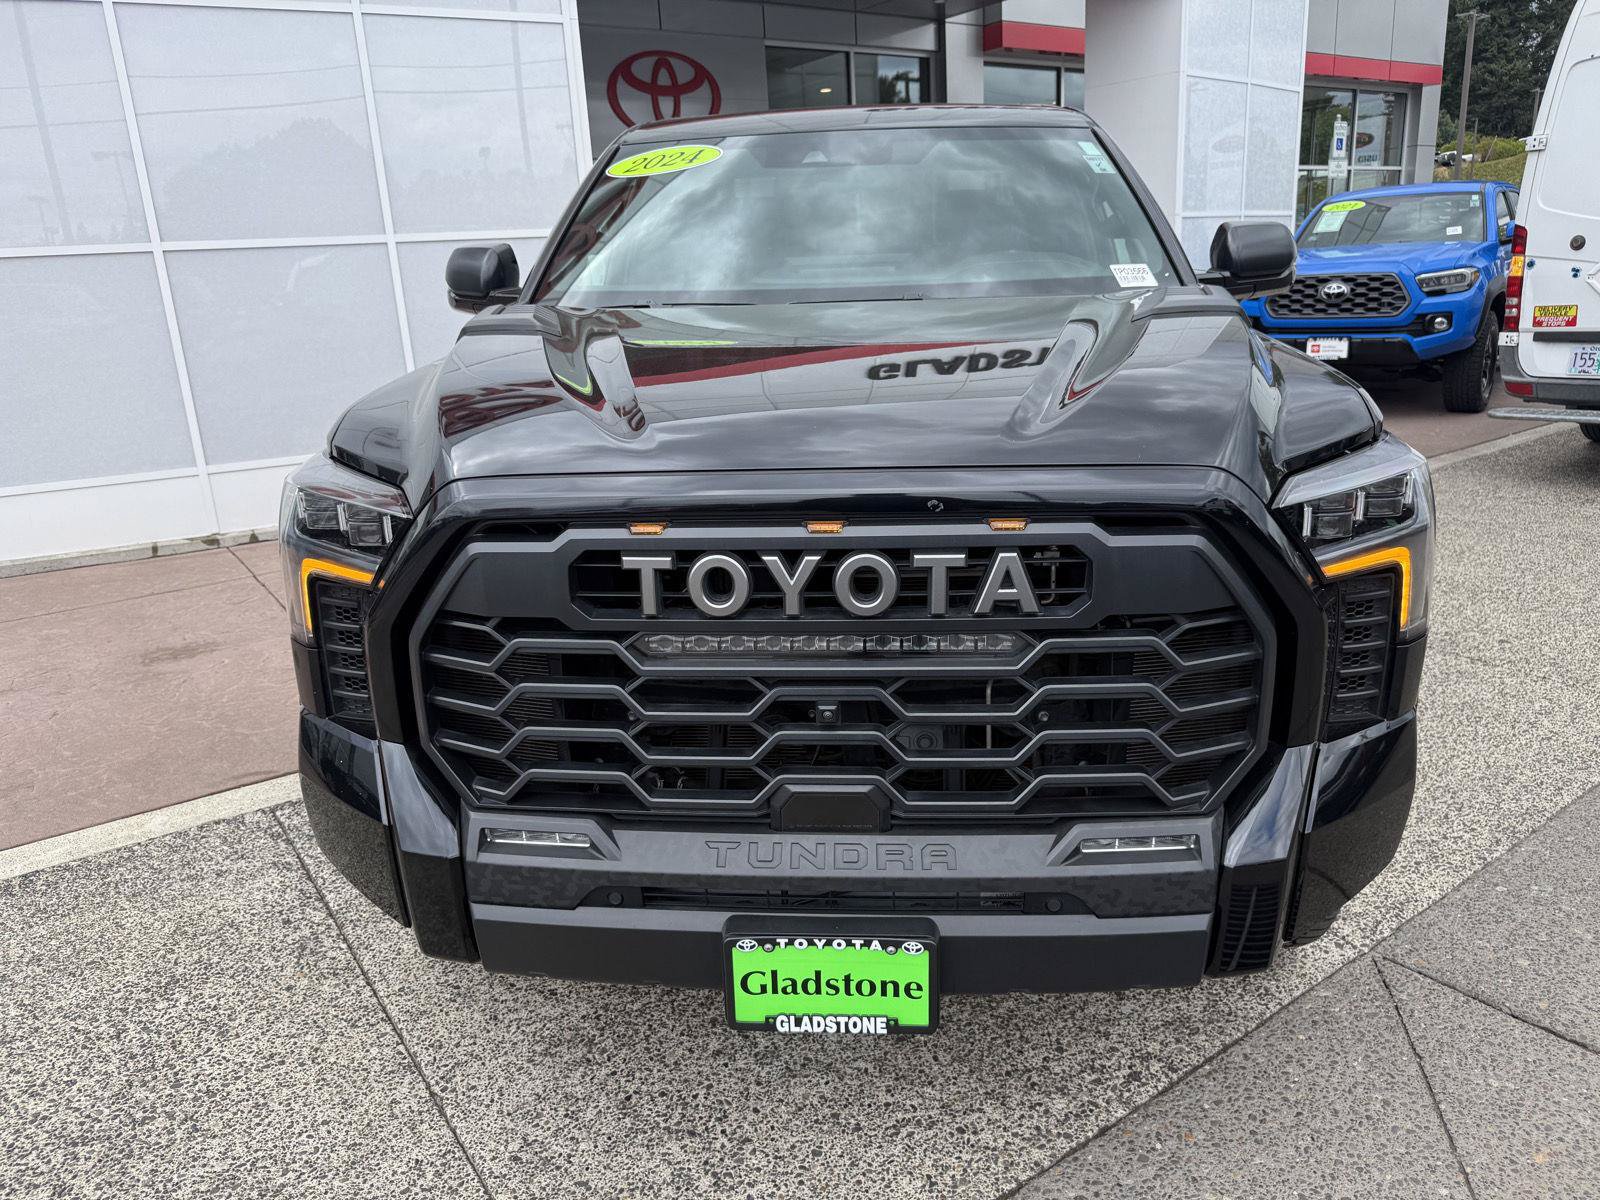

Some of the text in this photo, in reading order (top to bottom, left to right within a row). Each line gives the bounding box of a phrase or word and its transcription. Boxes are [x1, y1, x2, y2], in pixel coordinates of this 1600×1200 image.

[623, 149, 705, 174] 2024
[621, 551, 1041, 618] TOYOTA
[705, 840, 958, 871] TUNDRA
[776, 938, 883, 951] TOYOTA
[739, 969, 924, 1000] Gladstone
[776, 1014, 888, 1034] GLADSTONE
